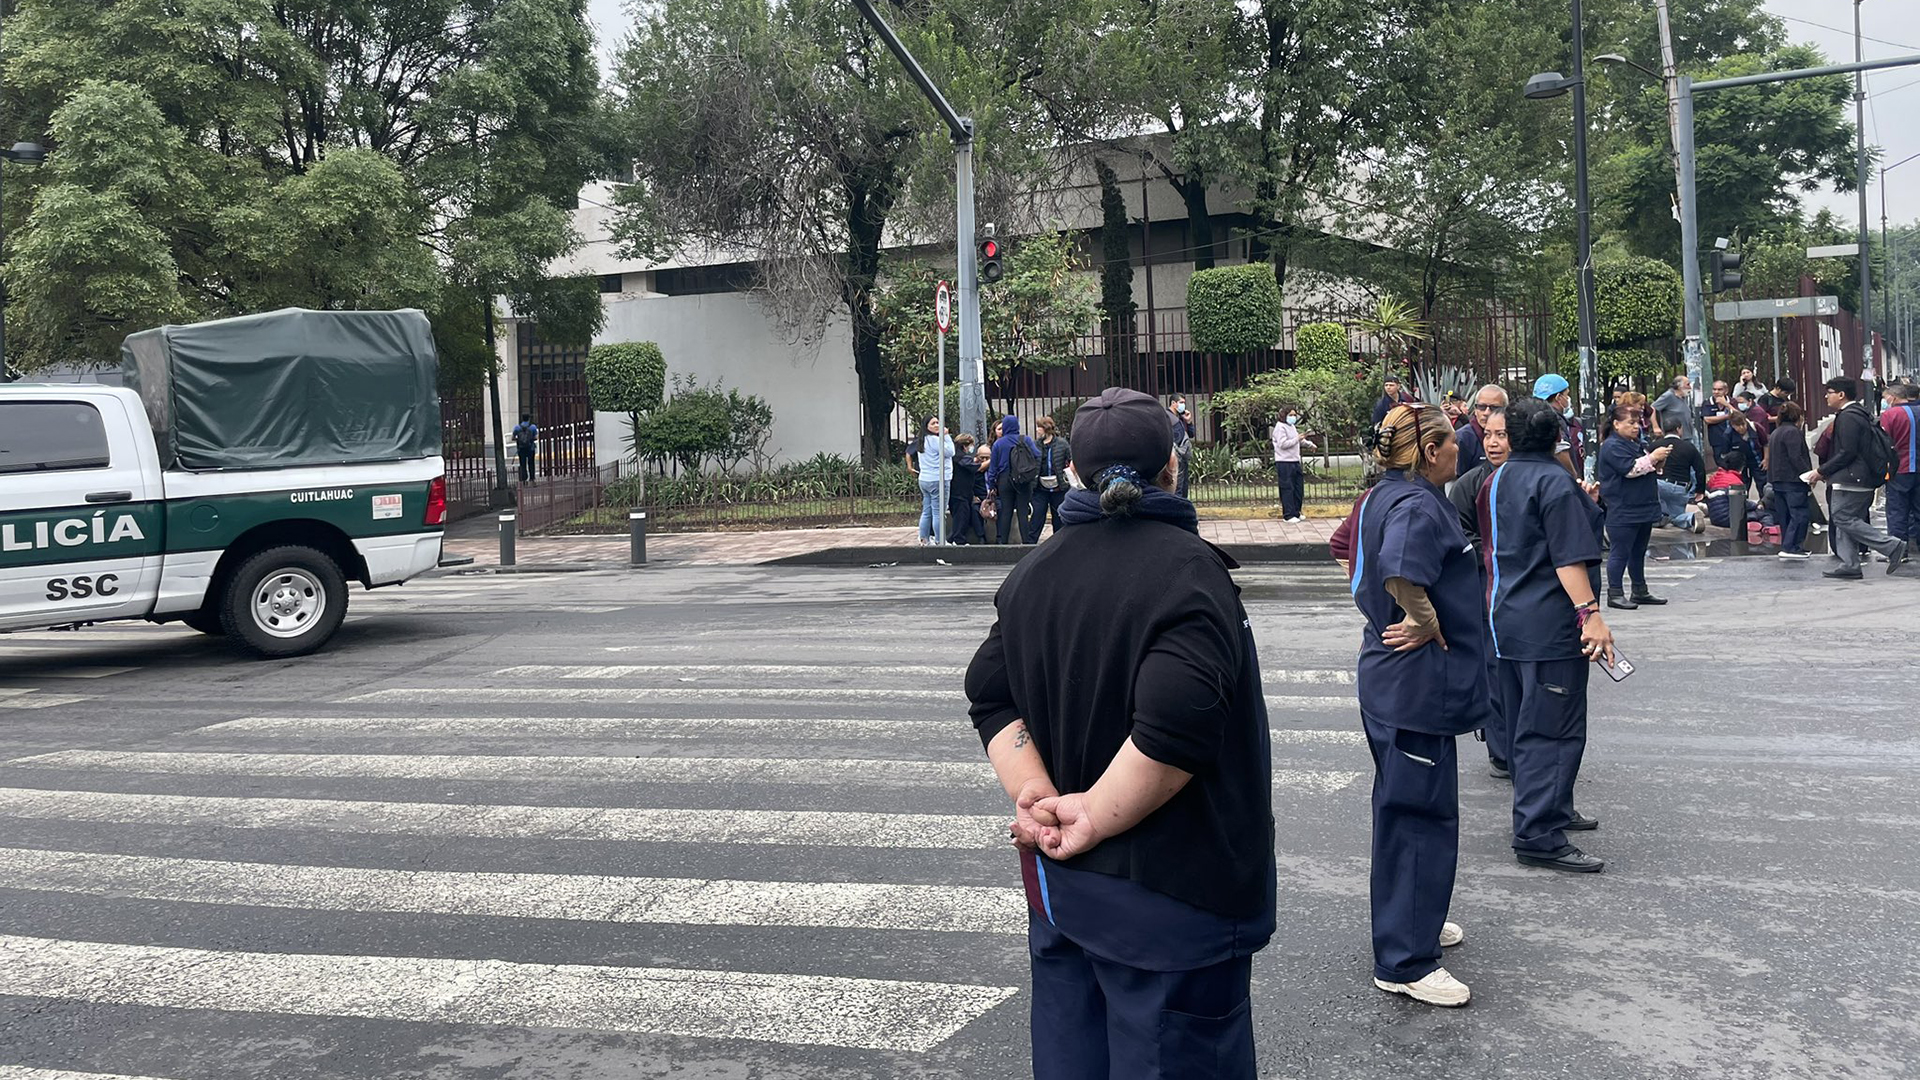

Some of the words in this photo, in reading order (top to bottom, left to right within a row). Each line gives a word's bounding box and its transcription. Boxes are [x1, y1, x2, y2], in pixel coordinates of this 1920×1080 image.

[290, 488, 354, 503] CUITLAHUAC
[2, 510, 145, 551] LICÍA
[46, 573, 119, 601] SSC
